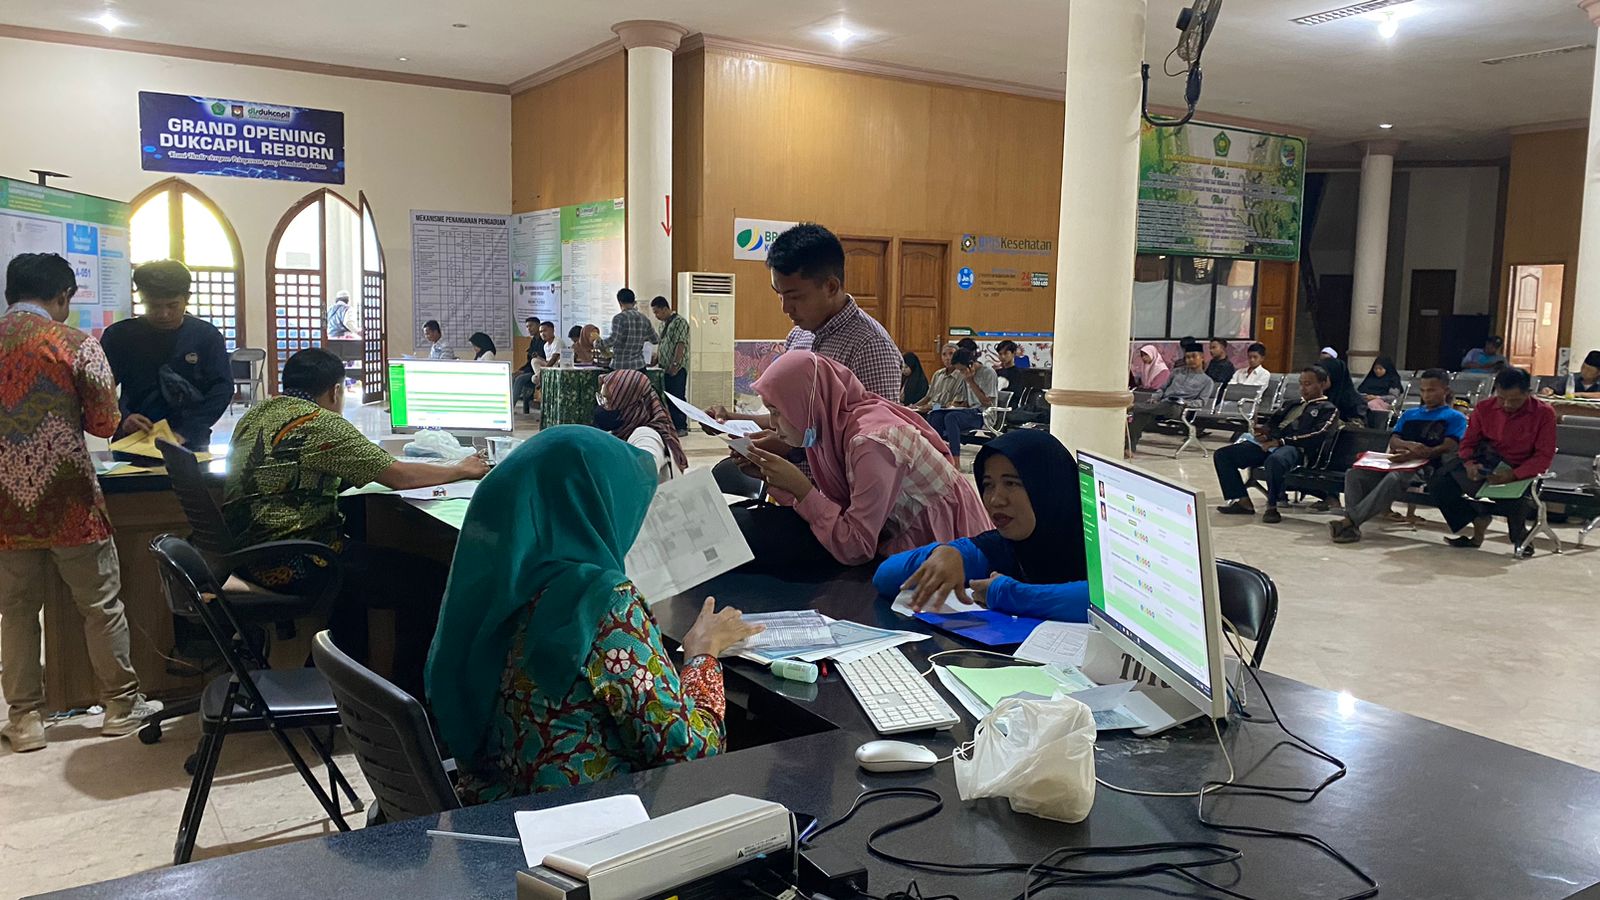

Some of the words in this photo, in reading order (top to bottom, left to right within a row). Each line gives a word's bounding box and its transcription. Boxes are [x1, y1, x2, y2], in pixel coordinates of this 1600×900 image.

[167, 117, 237, 137] GRAND
[242, 125, 326, 145] OPENING
[159, 133, 256, 153] DUKCAPIL
[261, 141, 334, 161] REBORN
[415, 214, 445, 223] MEKANISME
[445, 216, 478, 225] PENANGANAN
[478, 217, 506, 226] PENGADUAN
[1000, 237, 1052, 251] Kesehatan
